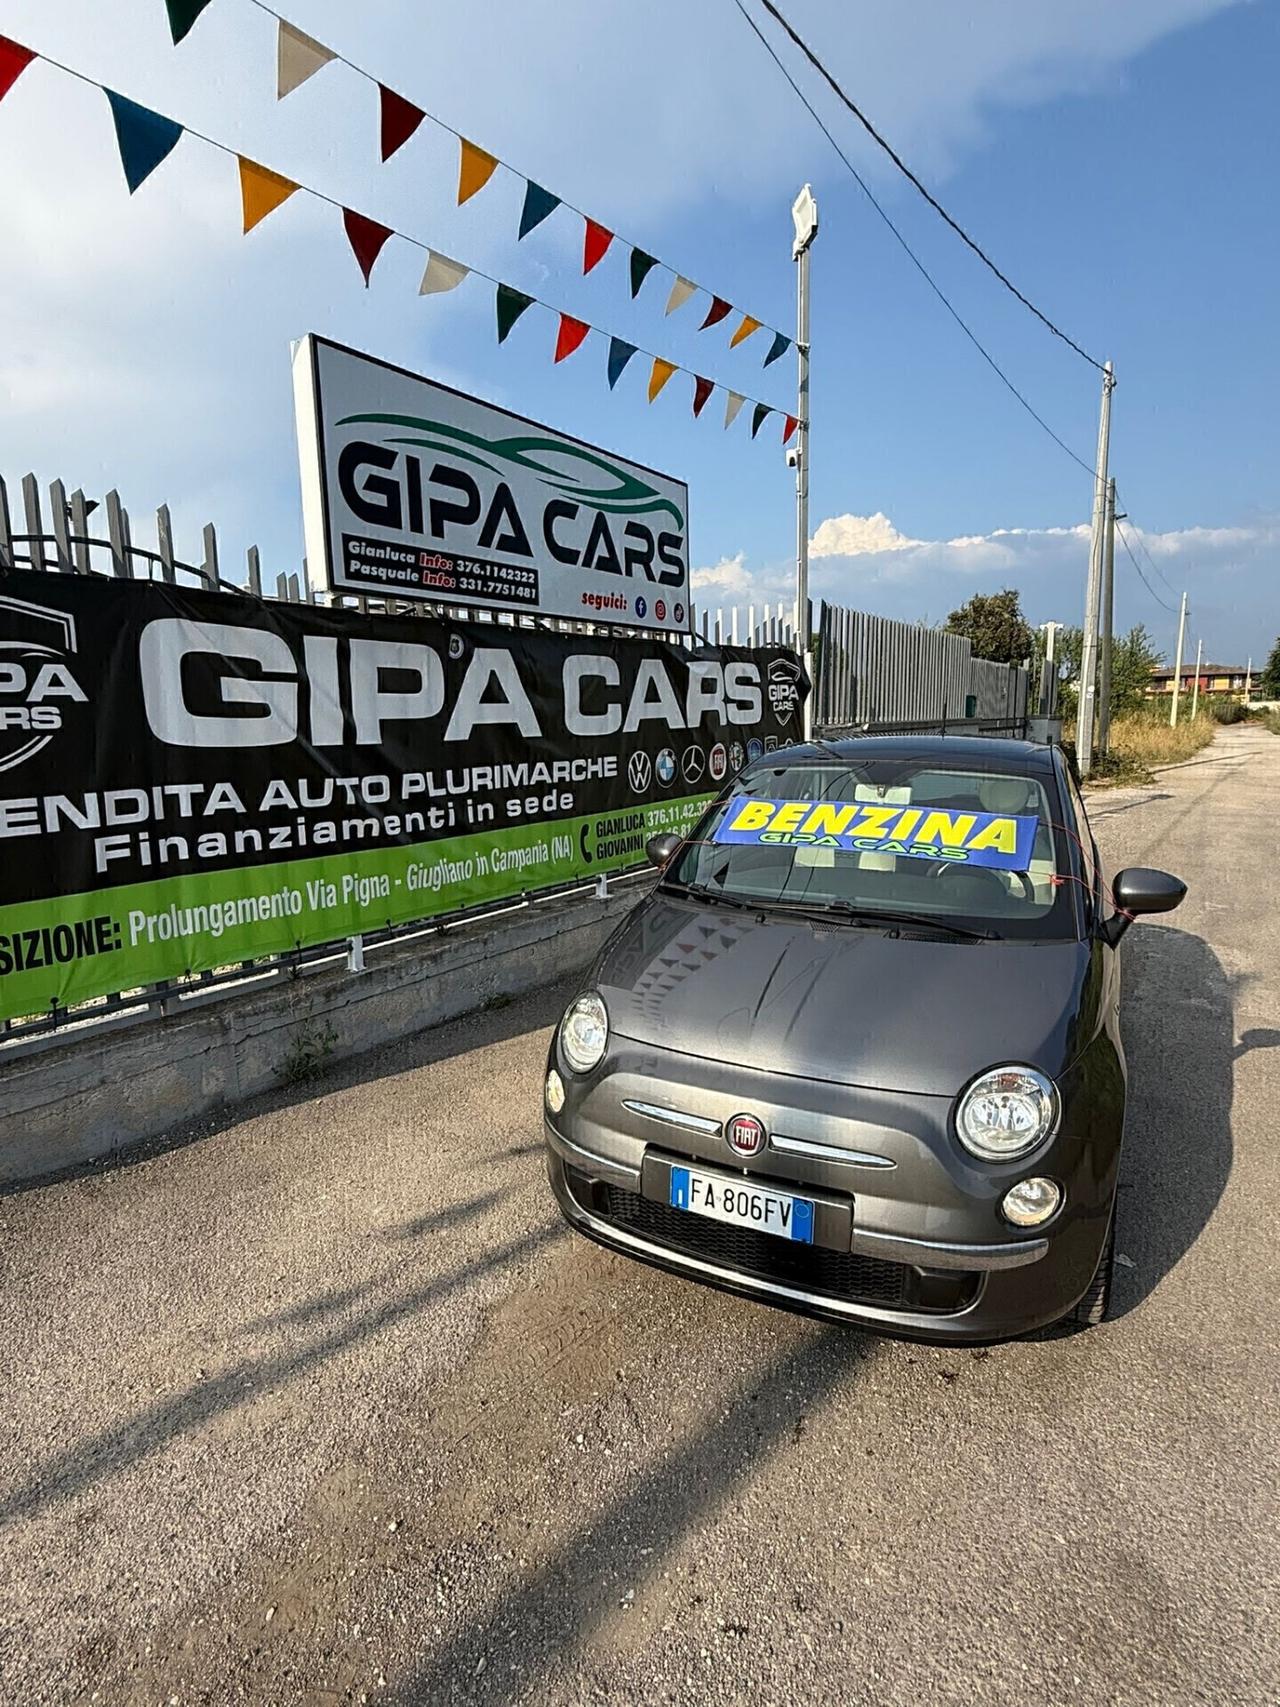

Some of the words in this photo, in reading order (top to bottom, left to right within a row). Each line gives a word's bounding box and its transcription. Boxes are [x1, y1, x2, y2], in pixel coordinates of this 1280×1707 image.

[338, 441, 534, 557] GIPA
[543, 499, 685, 588] CARS
[348, 541, 415, 563] Gianluca
[419, 552, 453, 571] Info:
[456, 560, 535, 584] 376.1142322
[350, 560, 419, 581] Pasquale
[422, 570, 456, 588] Info:
[459, 578, 536, 599] 331.7751481
[582, 592, 627, 611] seguici:
[139, 618, 543, 748] GIPA
[562, 654, 762, 736] CARS
[768, 684, 799, 701] GIPA
[773, 701, 794, 711] CARS
[258, 775, 390, 811] AUTO
[402, 755, 618, 799] PLURIMARCHE
[94, 802, 456, 873] Finanziamenti
[467, 799, 495, 823] in
[506, 789, 574, 817] sede
[596, 812, 645, 838] GIANLUCA
[728, 799, 1017, 855] BENZINA
[596, 834, 644, 860] GIOVANNI
[758, 832, 842, 848] GIPA
[852, 837, 970, 861] CARS
[128, 887, 302, 946] Prolungamento
[306, 877, 337, 911] Via
[342, 873, 390, 906] Pigna
[406, 855, 473, 892] Giugliano
[475, 851, 489, 876] in
[491, 839, 549, 872] Campania
[551, 834, 574, 865] (NA)
[735, 1126, 758, 1146] FIAT
